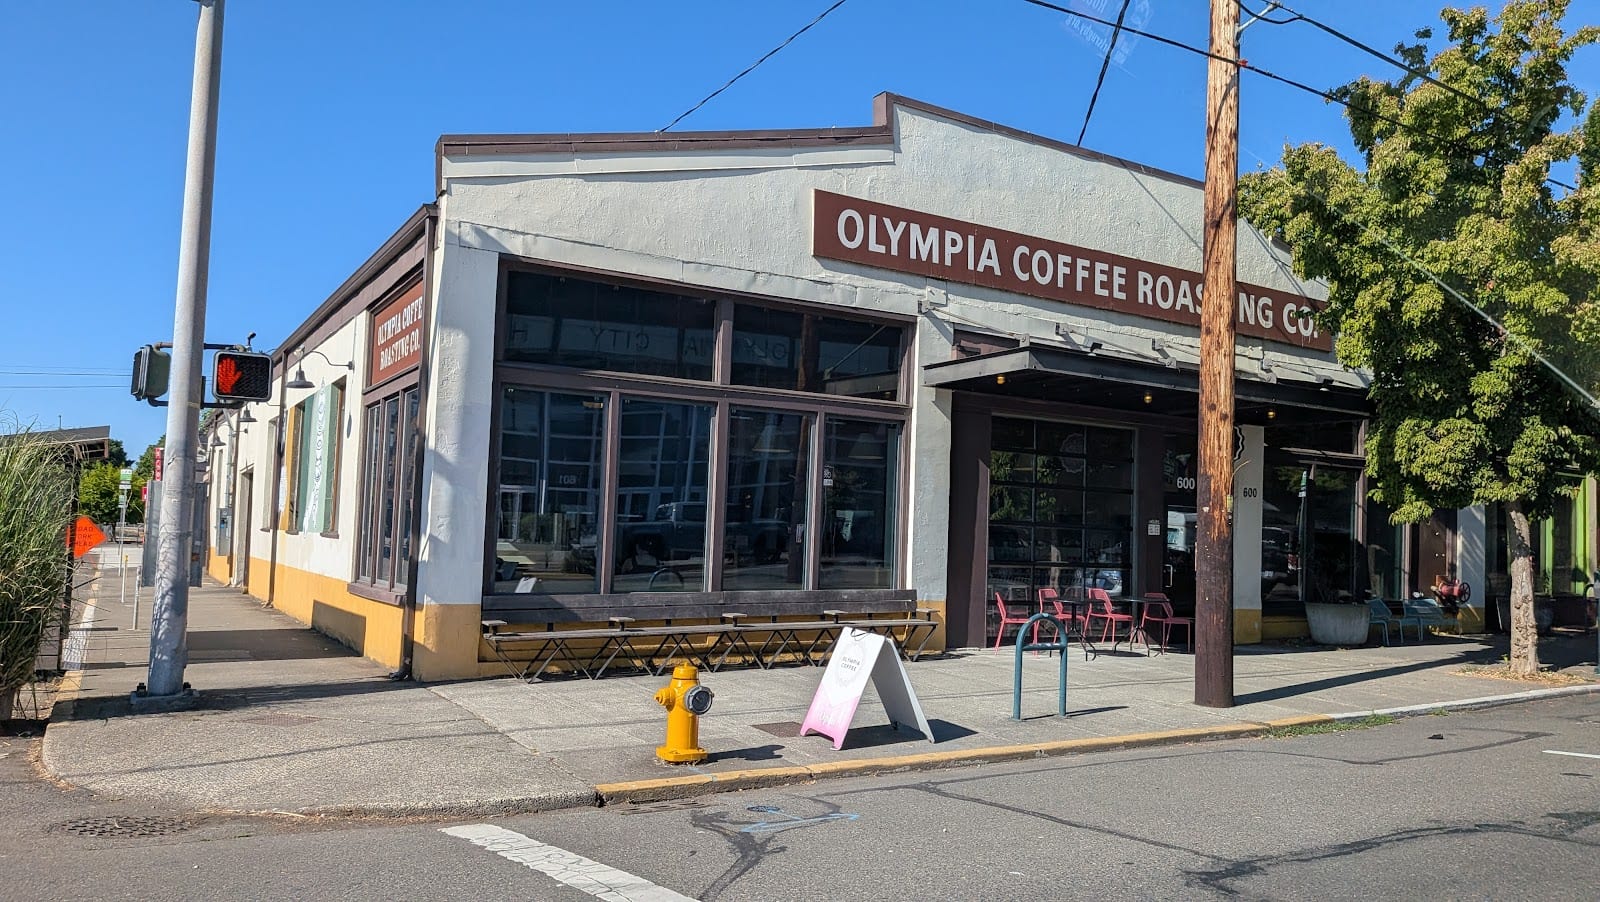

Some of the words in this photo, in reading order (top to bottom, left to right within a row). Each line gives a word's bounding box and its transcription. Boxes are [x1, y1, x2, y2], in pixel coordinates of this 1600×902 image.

[837, 208, 1002, 276] OLYMPIA
[1012, 245, 1127, 300] COFFEE
[1138, 270, 1273, 329] ROASNG
[1283, 302, 1318, 338] CO.
[377, 312, 402, 346] OLYMPIA
[402, 295, 423, 330] COFFE
[379, 333, 410, 371] ROASTING
[1176, 476, 1196, 490] 600
[1243, 487, 1258, 498] 600
